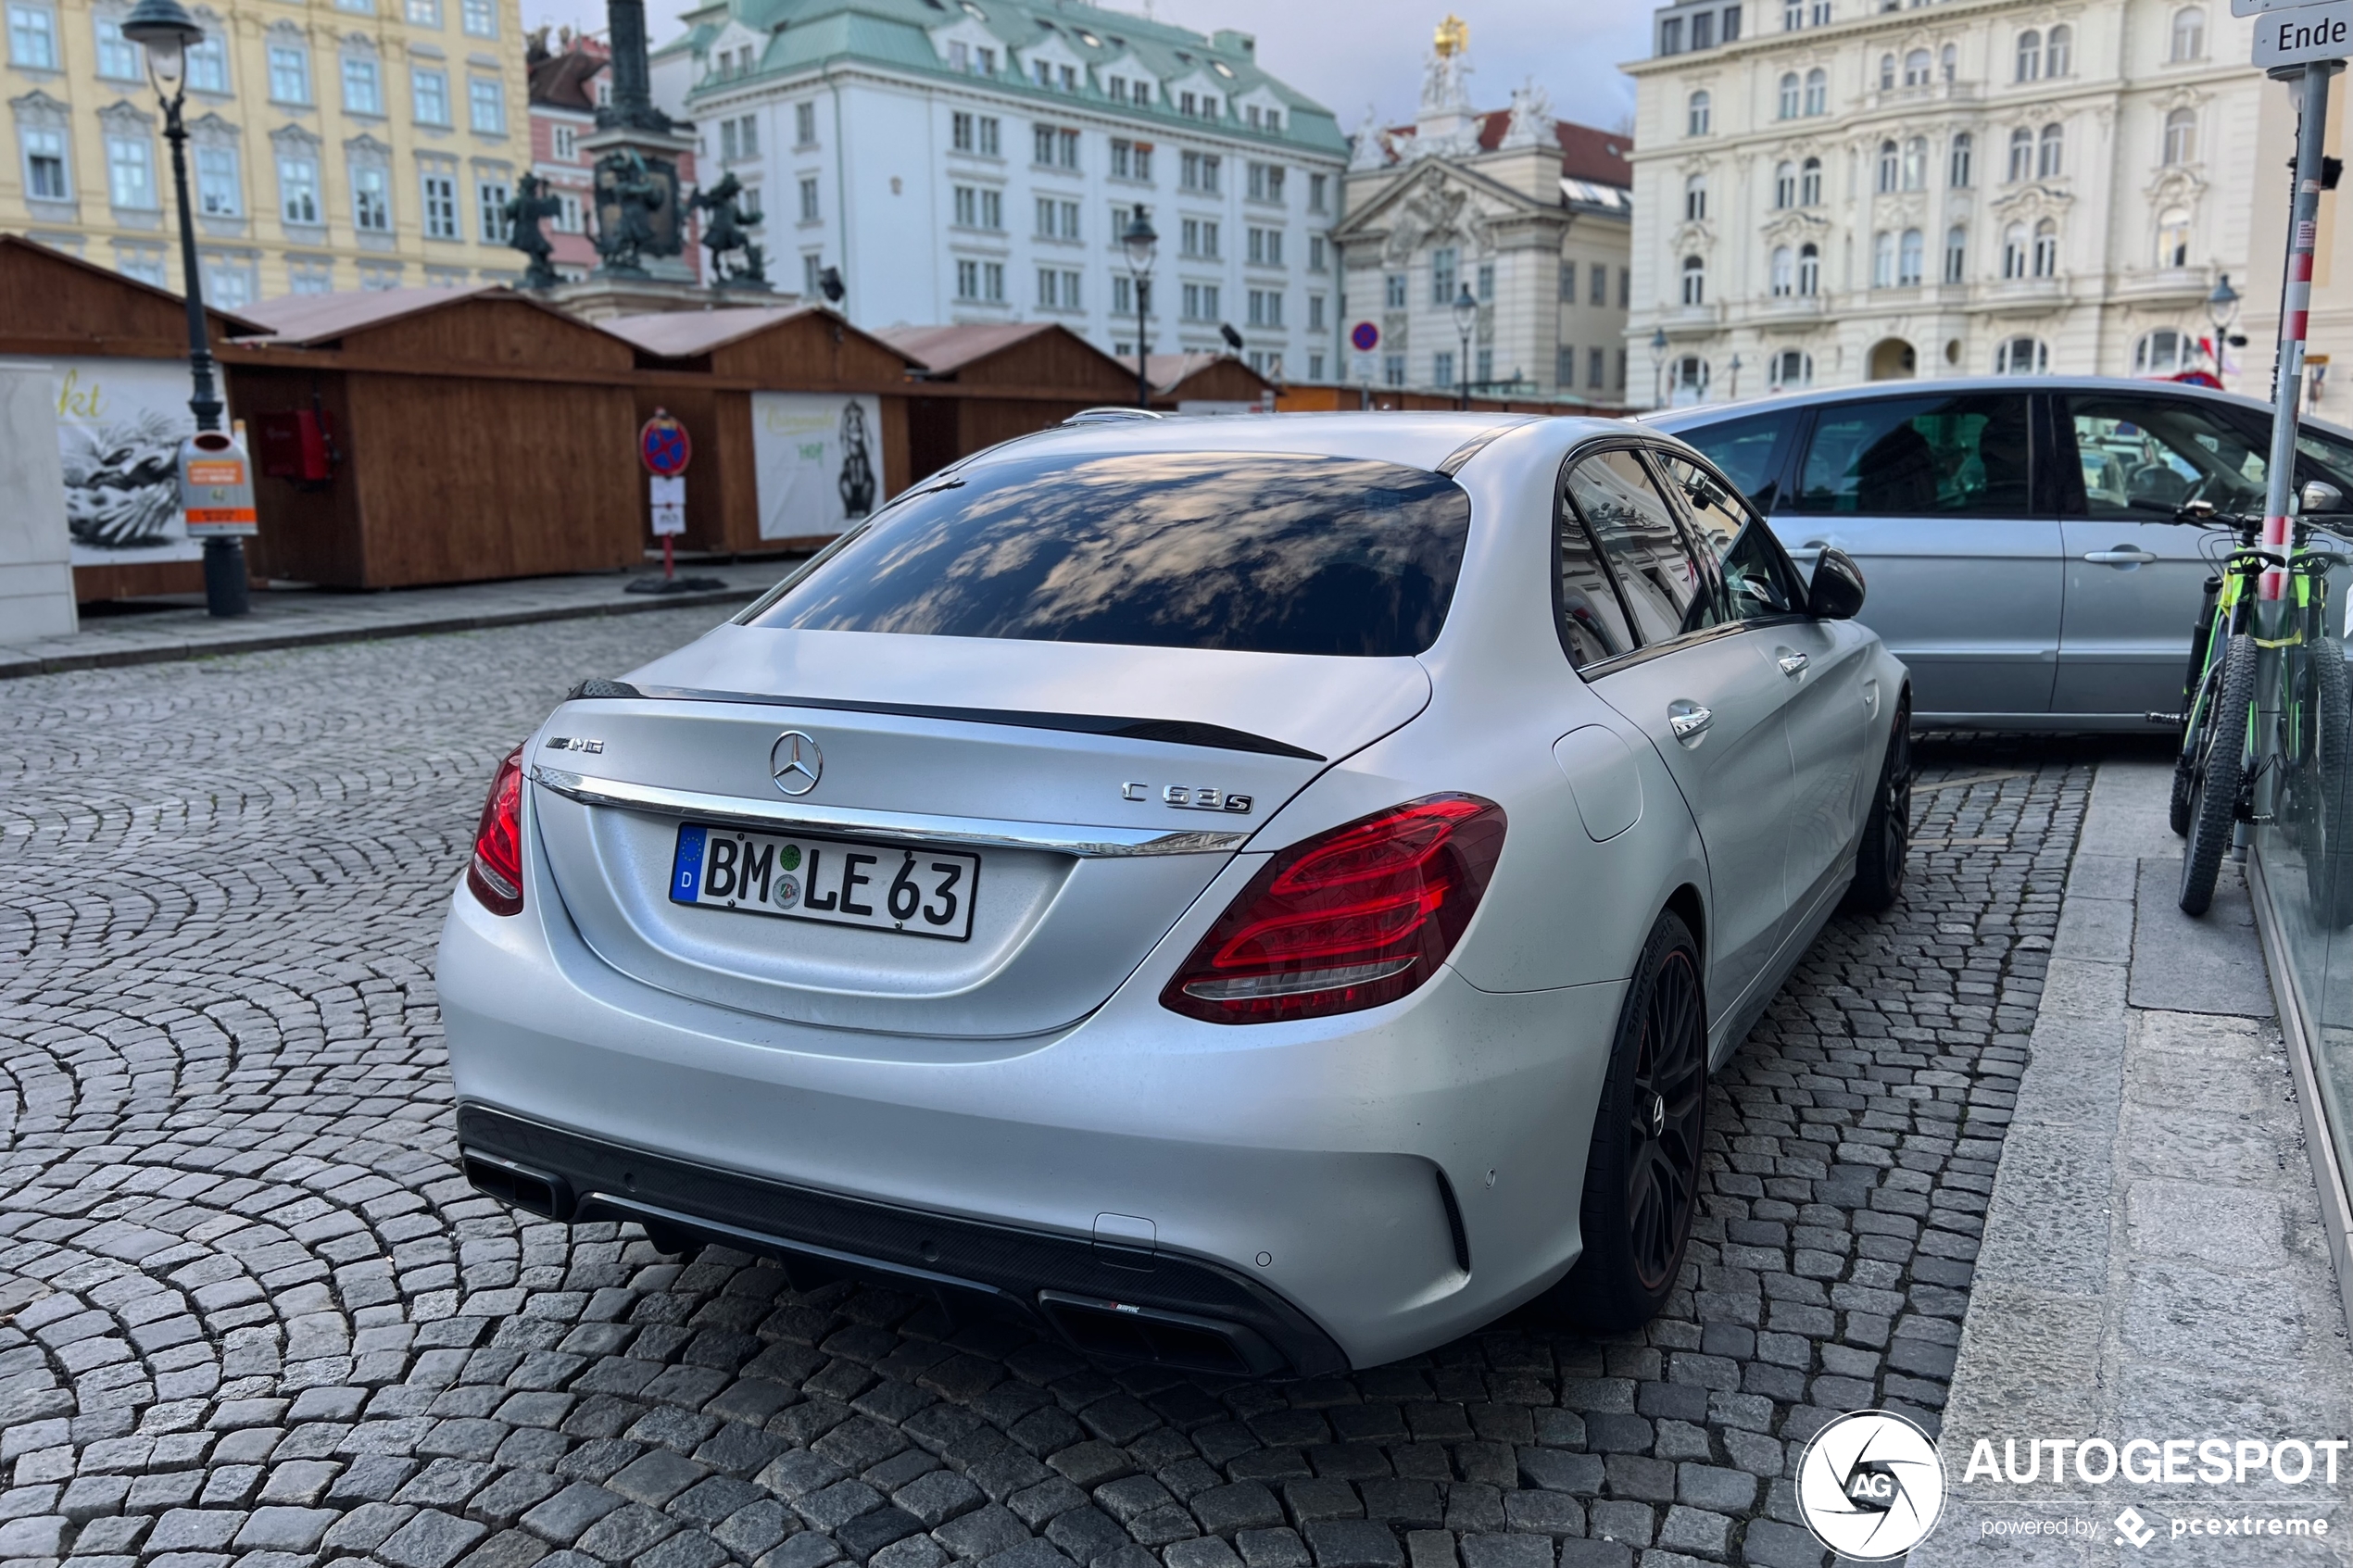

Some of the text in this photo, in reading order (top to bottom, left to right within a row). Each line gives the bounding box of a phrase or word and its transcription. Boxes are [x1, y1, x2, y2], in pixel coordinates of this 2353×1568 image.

[2279, 18, 2347, 51] Ende
[1122, 781, 1149, 802] C
[681, 872, 692, 888] D
[704, 838, 774, 903] BM
